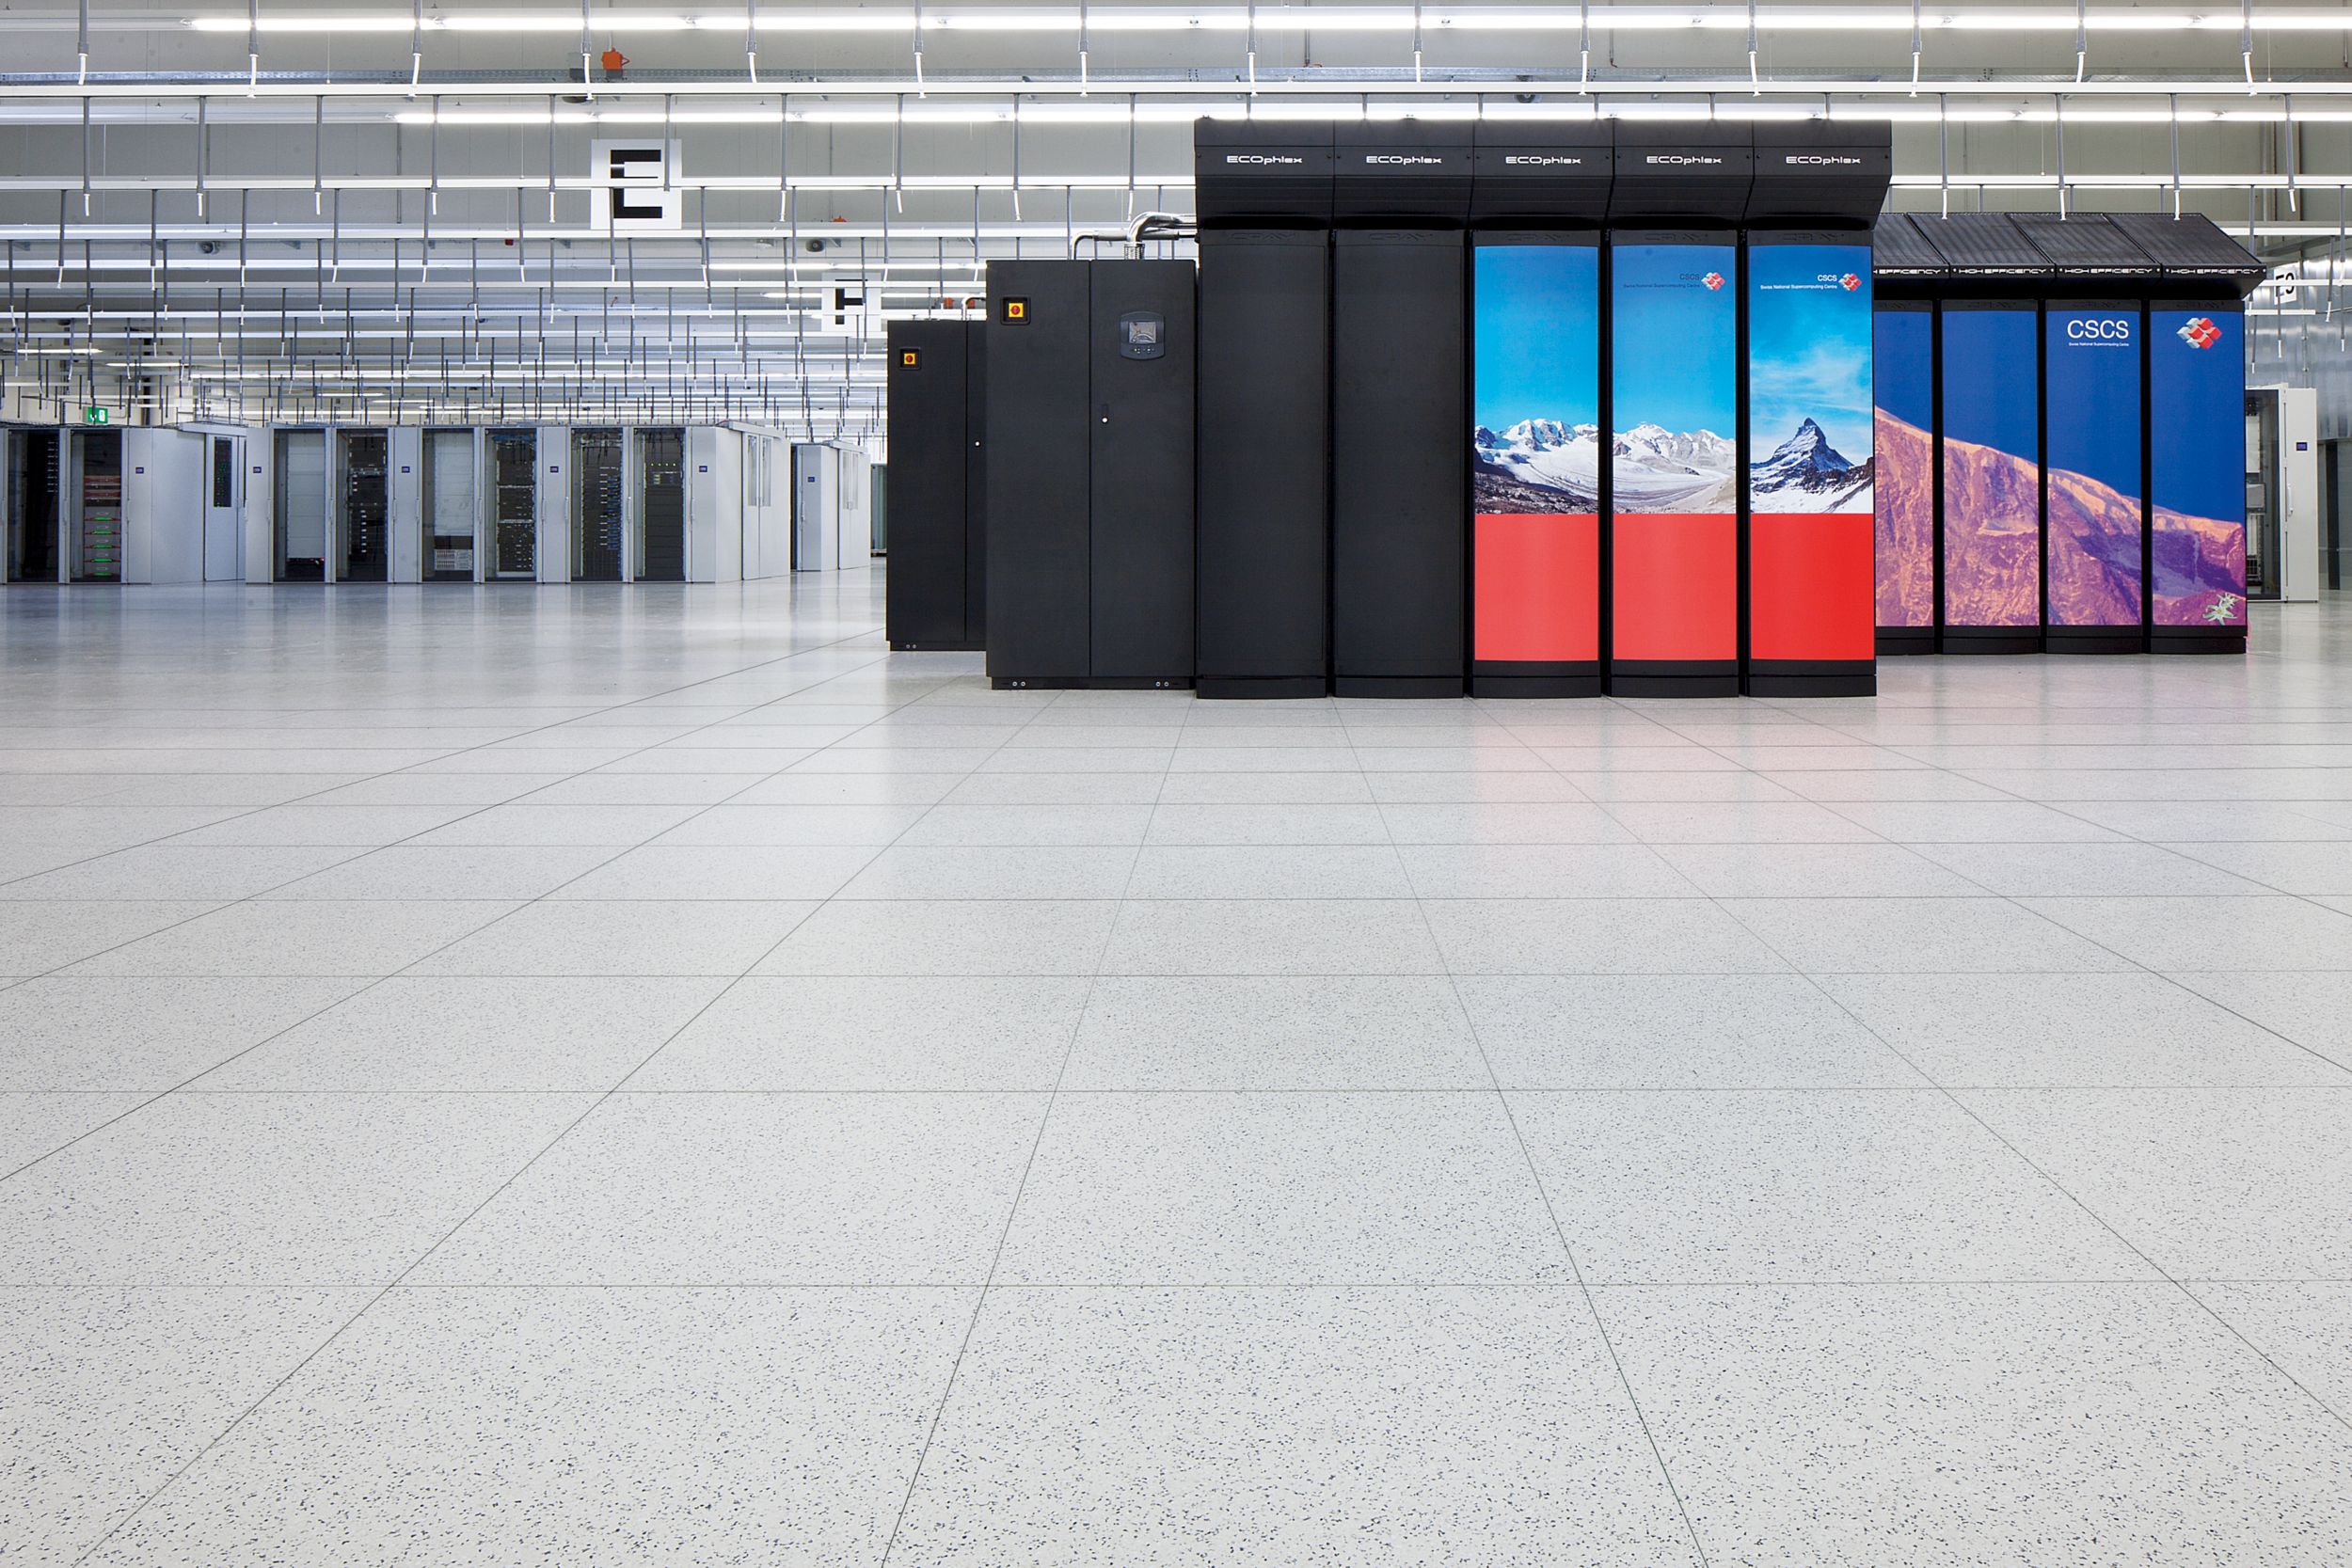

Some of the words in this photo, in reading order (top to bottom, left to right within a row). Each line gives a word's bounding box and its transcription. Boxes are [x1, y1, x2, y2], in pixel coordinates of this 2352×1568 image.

[1226, 155, 1302, 166] ECOphlex
[1365, 155, 1442, 166] ECOphlex
[1504, 156, 1581, 166] ECOphlex
[1645, 155, 1723, 166] ECOphlex
[1785, 155, 1861, 166] ECOphlex
[610, 150, 662, 218] E
[2067, 319, 2129, 340] CSCS
